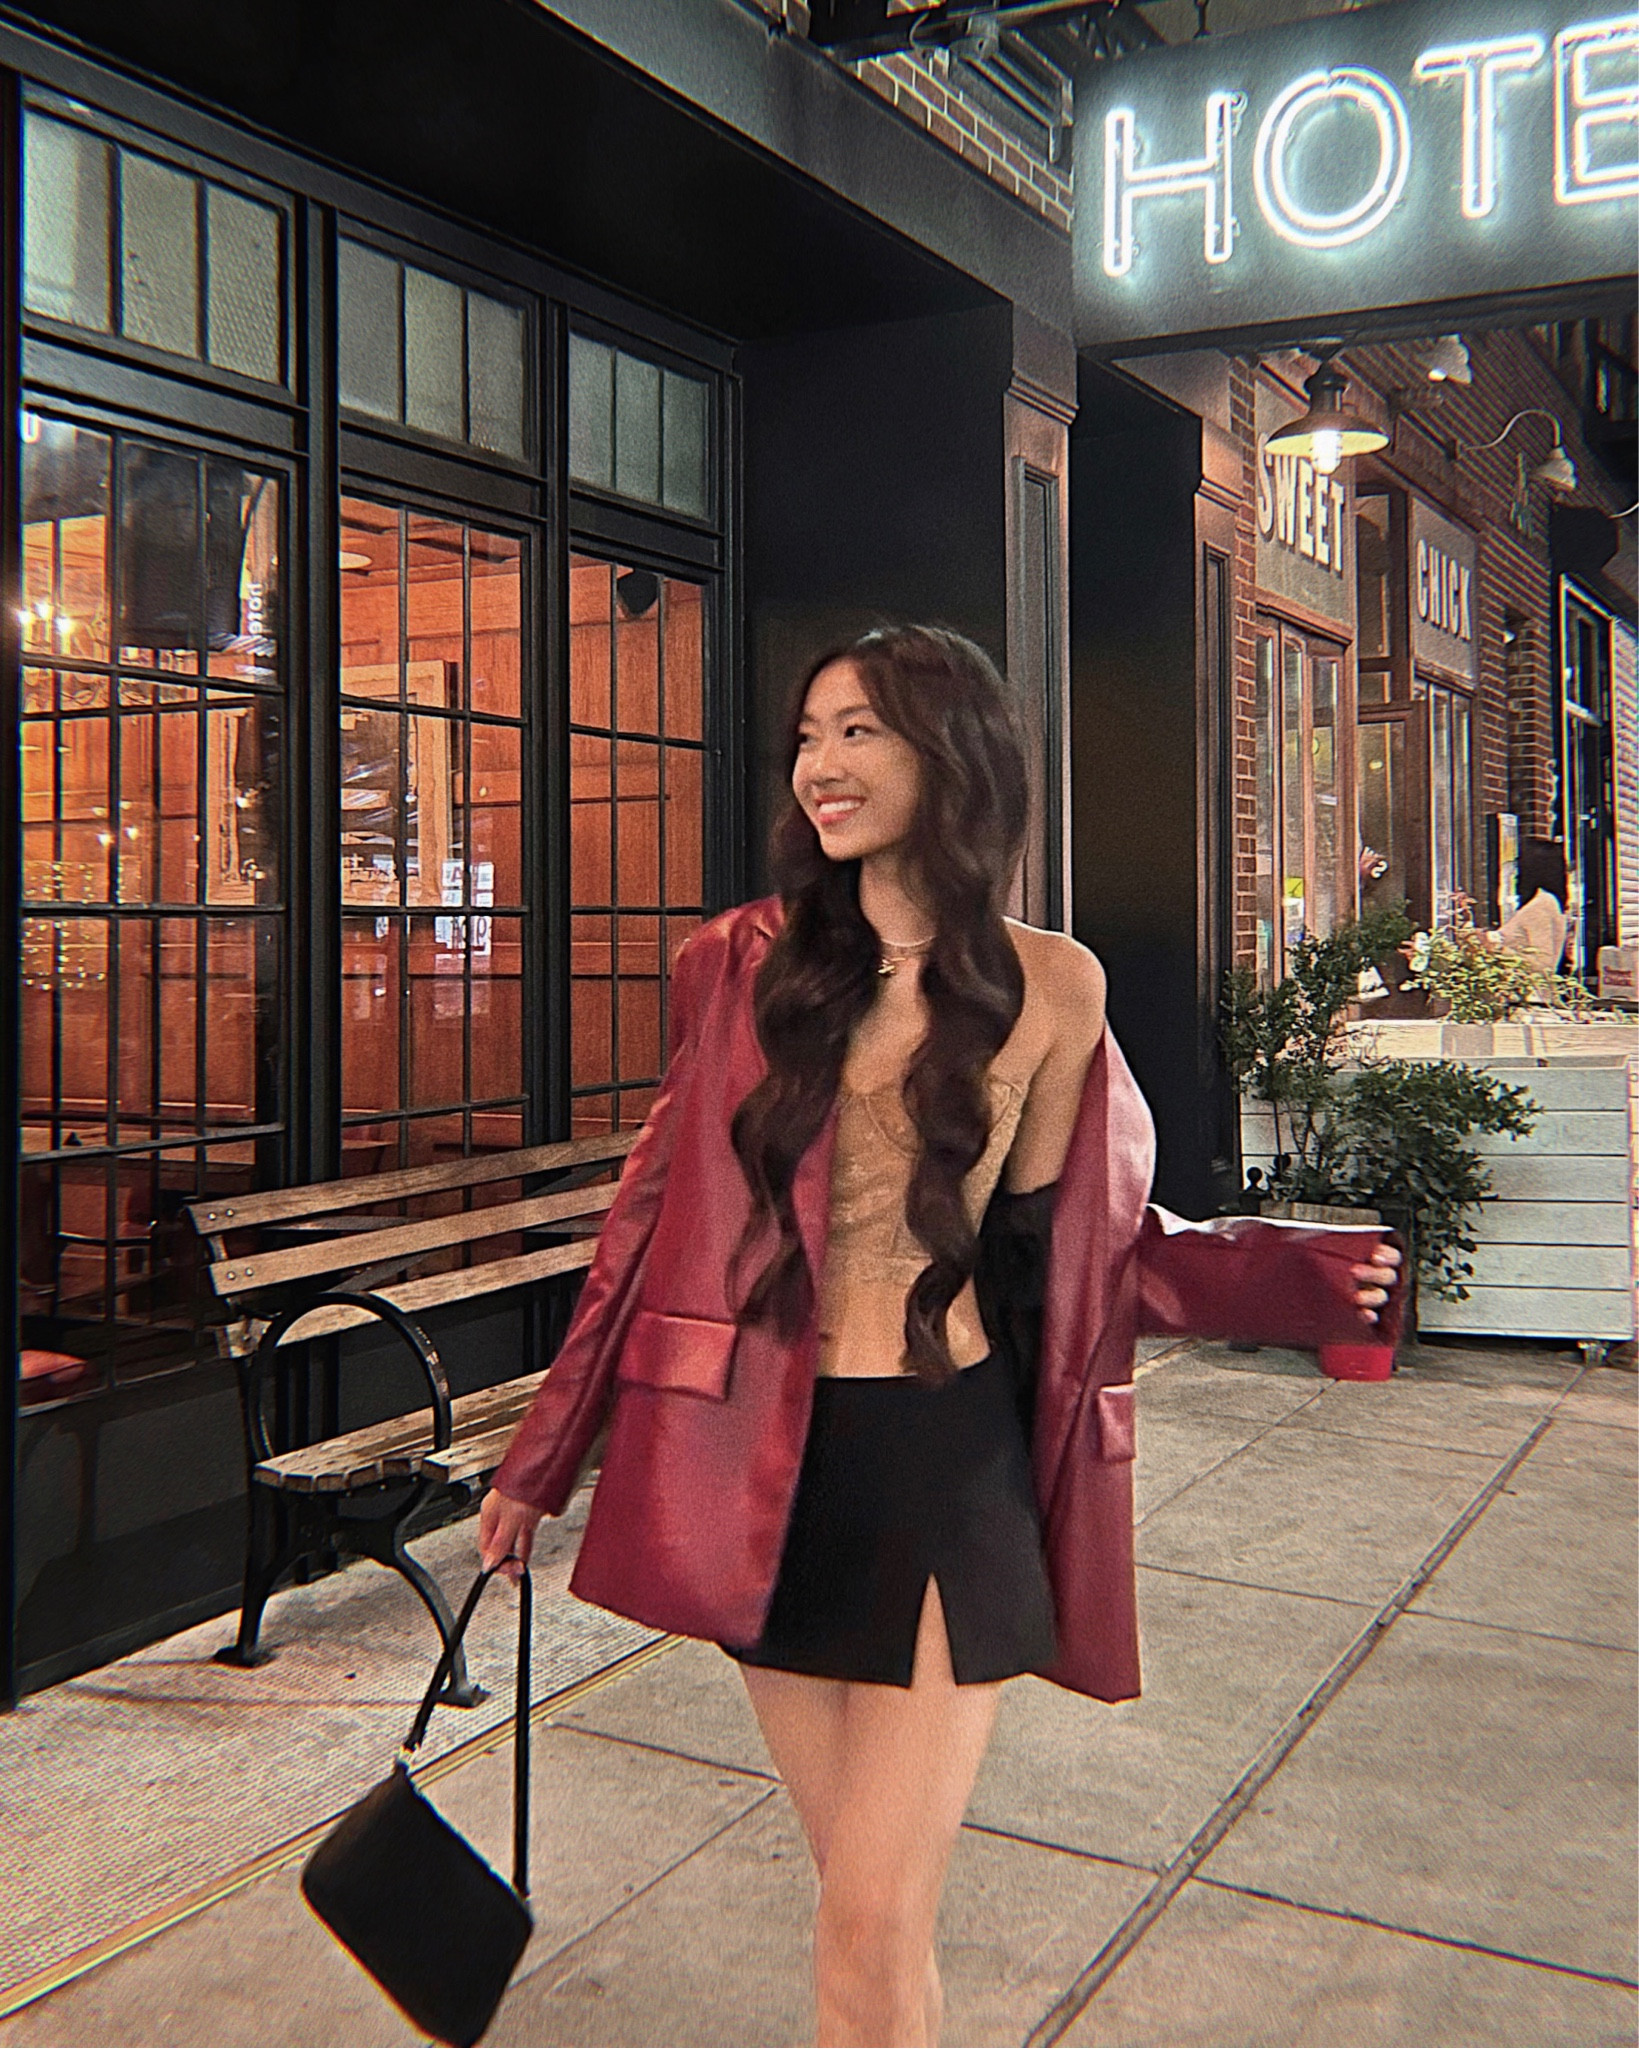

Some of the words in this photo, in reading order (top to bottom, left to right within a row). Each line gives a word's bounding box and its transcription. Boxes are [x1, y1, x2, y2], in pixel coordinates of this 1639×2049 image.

[1103, 14, 1639, 277] HOTE
[1257, 432, 1344, 572] SWEET
[1416, 538, 1472, 641] CHICK
